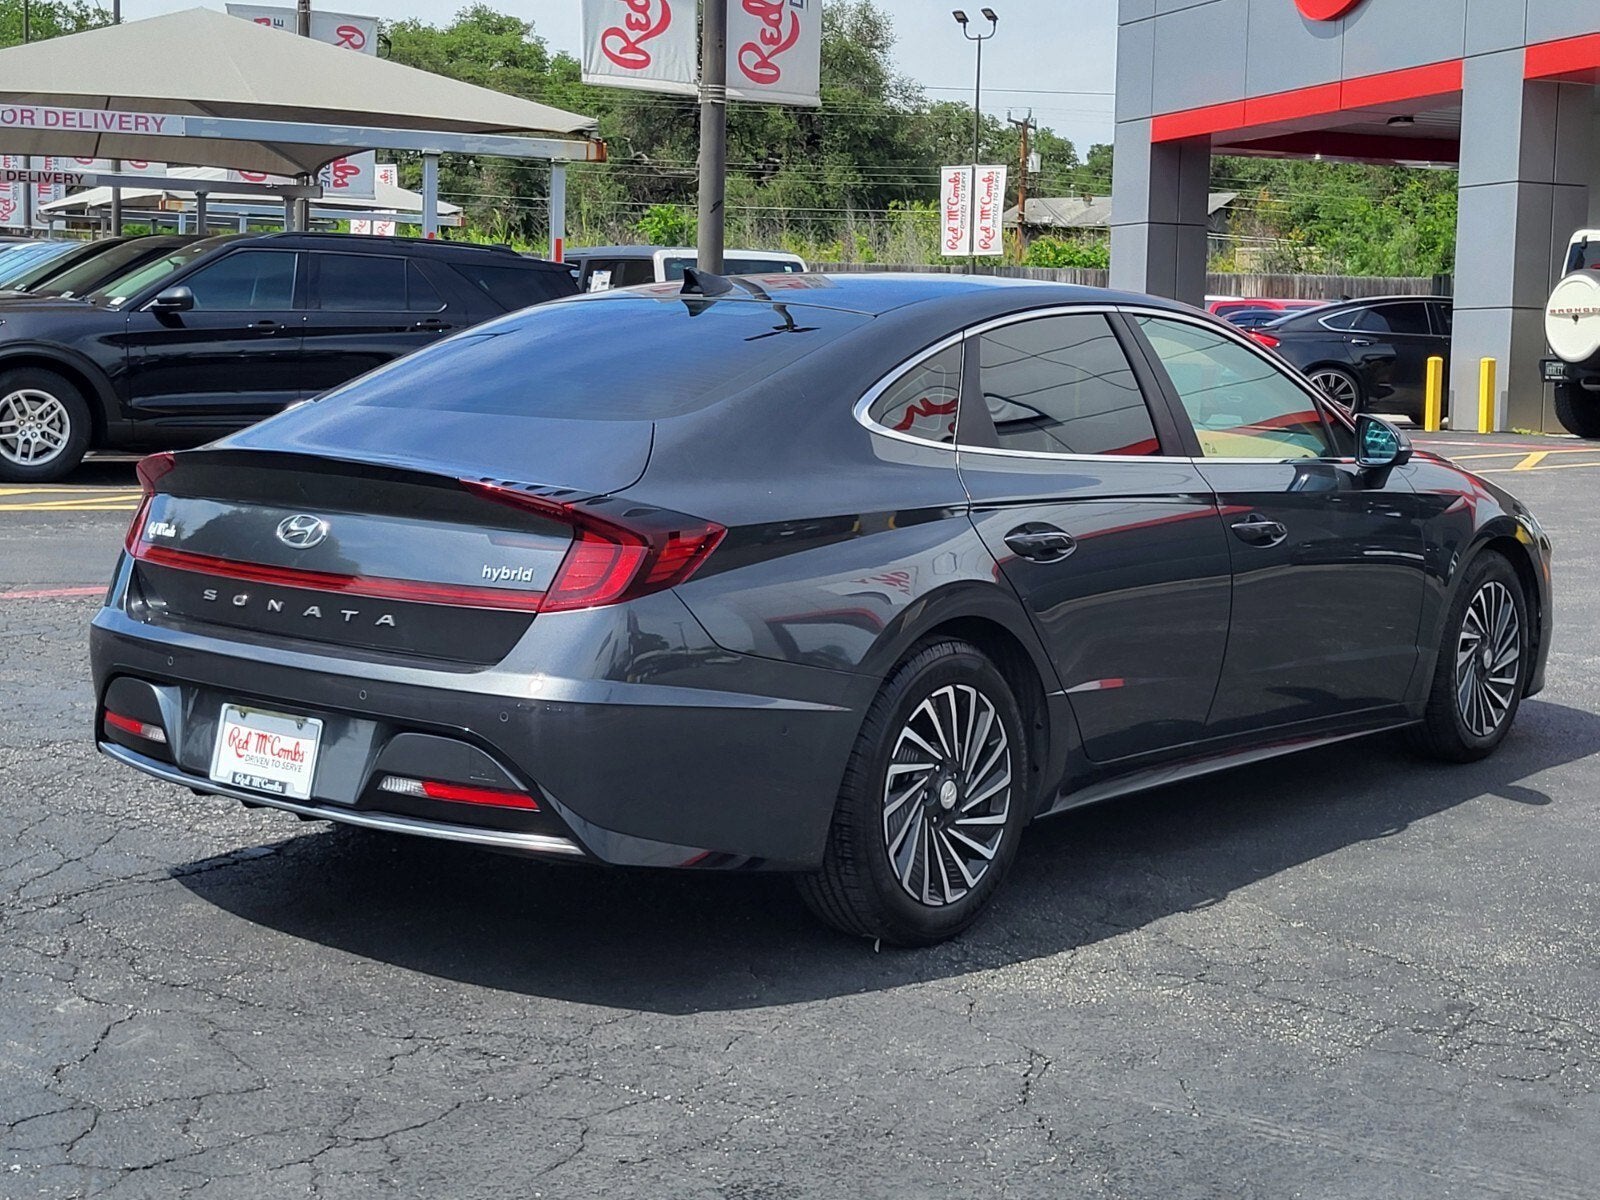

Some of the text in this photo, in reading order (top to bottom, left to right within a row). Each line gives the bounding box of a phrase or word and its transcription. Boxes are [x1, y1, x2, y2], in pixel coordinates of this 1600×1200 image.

[44, 109, 166, 133] DELIVERY
[6, 170, 84, 185] DELIVERY
[946, 172, 963, 250] Red McCombs
[979, 171, 995, 250] Red McCombs
[482, 564, 535, 583] hybrid
[203, 589, 396, 628] SONATA
[228, 726, 304, 763] Red McCombs
[244, 754, 303, 773] DRIVEN TO SERVE
